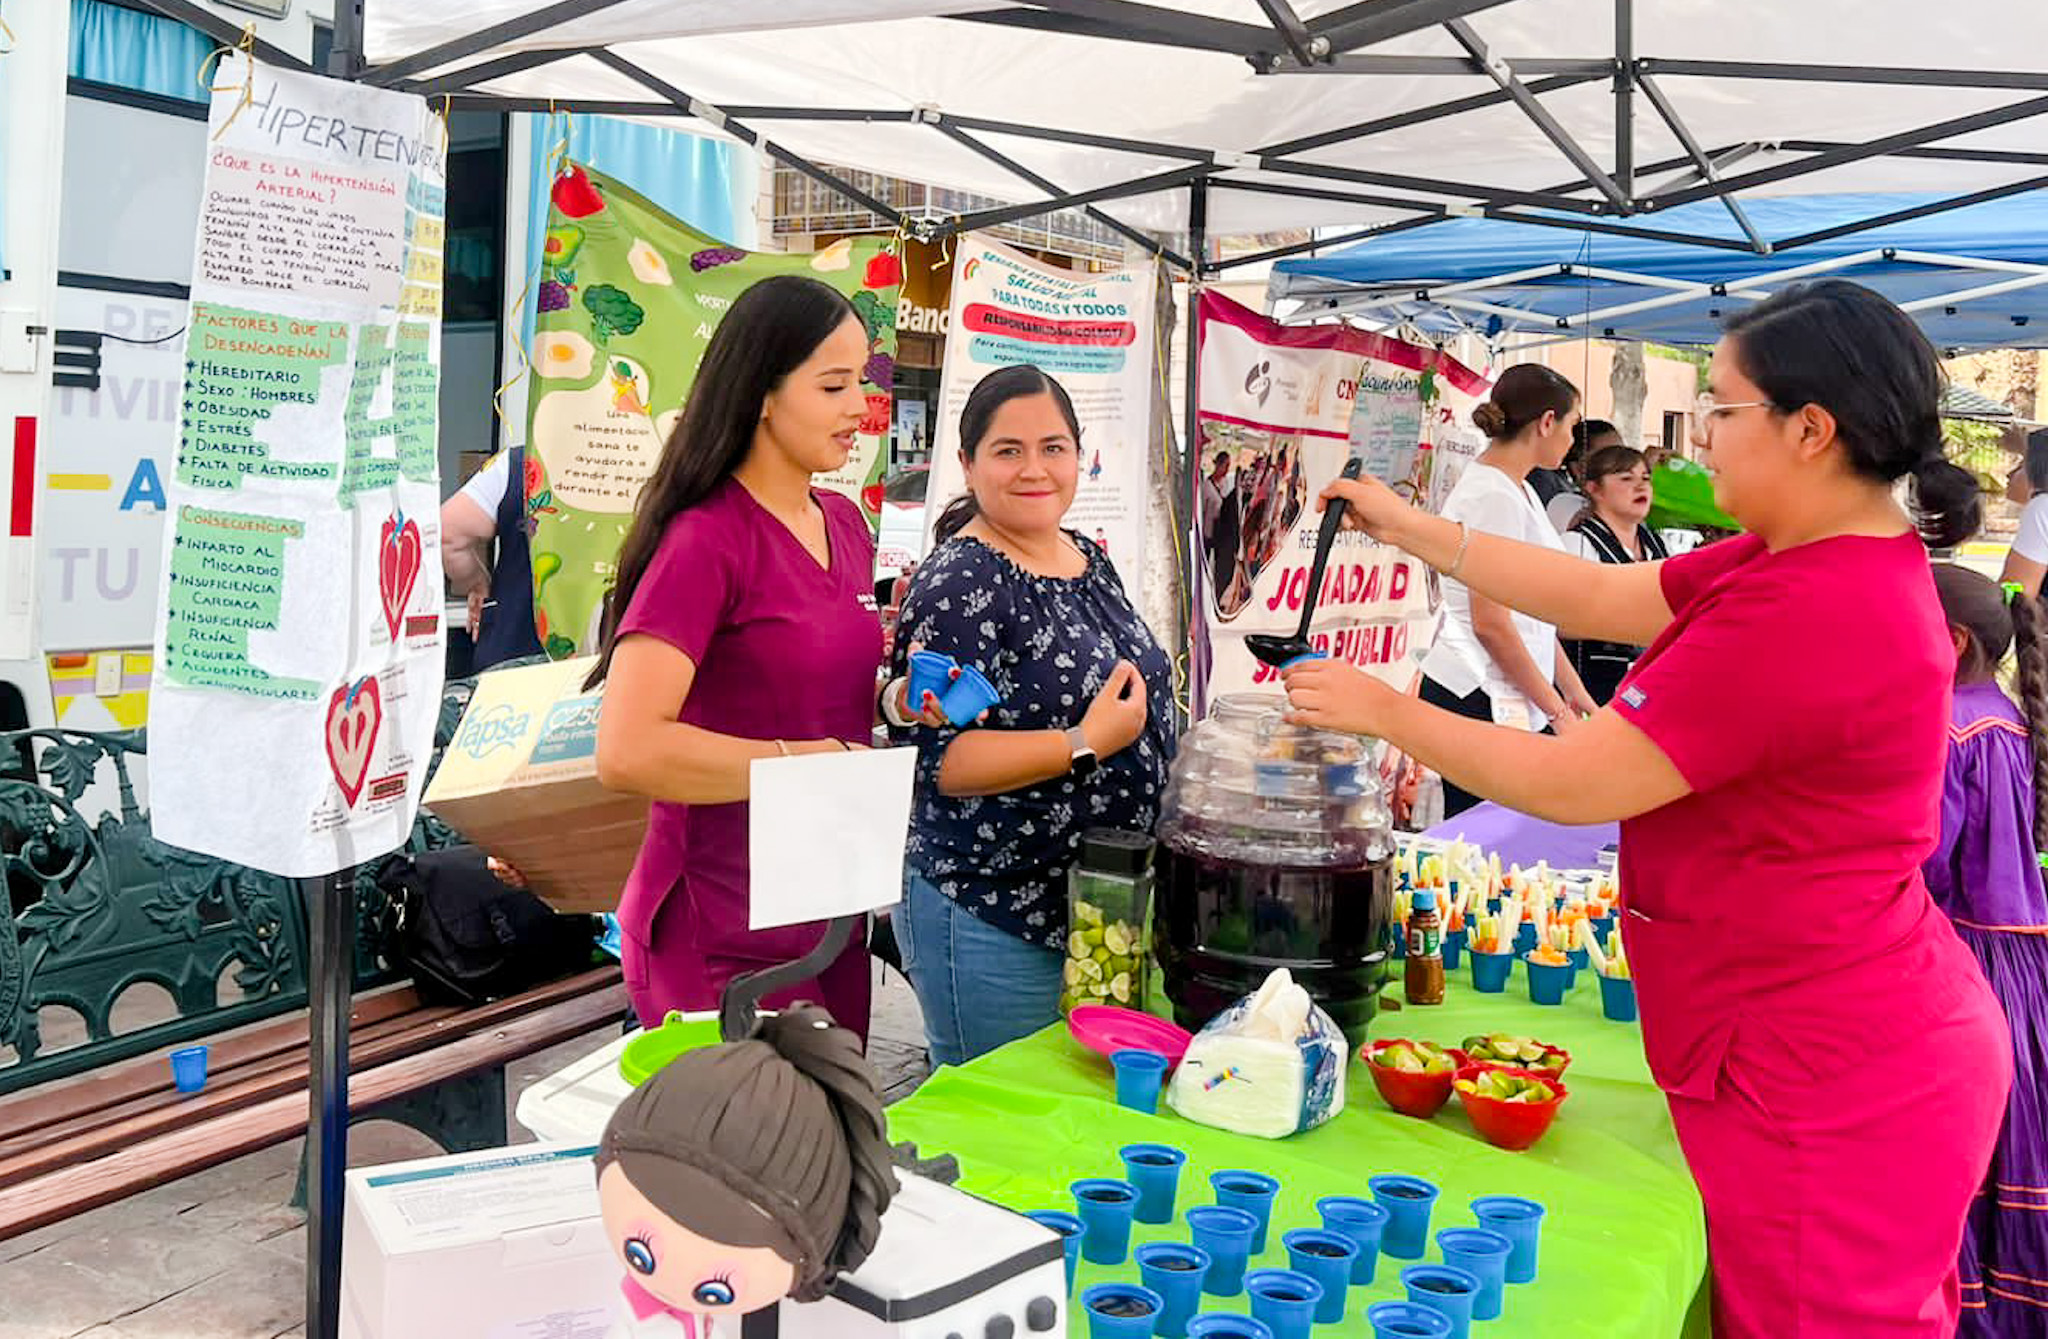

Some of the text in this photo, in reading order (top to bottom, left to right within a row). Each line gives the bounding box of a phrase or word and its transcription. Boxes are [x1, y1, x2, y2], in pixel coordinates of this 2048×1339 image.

[1072, 303, 1128, 316] TODOS
[193, 306, 279, 333] FACTORES
[289, 322, 319, 336] QUE
[330, 325, 347, 339] LA
[200, 360, 301, 384] HEREDITARIO
[198, 380, 235, 396] SEXO
[250, 387, 318, 405] HOMBRES
[198, 400, 272, 419] OBESIDAD
[196, 438, 266, 457] DIABETES
[191, 456, 330, 478] FALTA DE ACTIVIDAD
[187, 538, 275, 558] INFARTO AL
[202, 557, 280, 577] MIOCARDIO
[180, 575, 276, 594] INSUFICIENCIA
